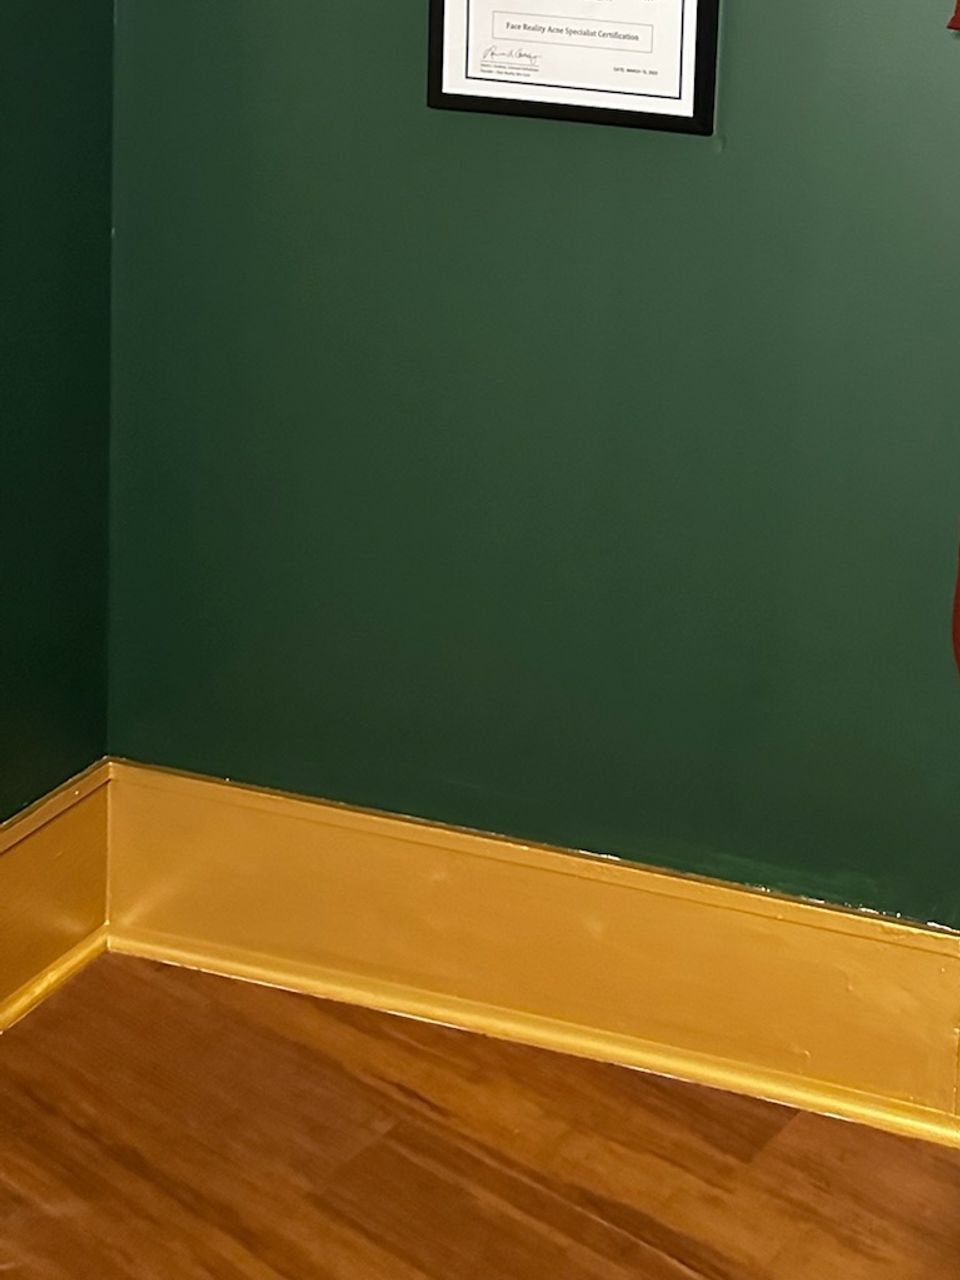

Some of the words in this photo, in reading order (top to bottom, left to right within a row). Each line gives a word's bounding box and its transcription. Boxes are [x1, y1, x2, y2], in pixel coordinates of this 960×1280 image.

[505, 21, 522, 31] Face
[522, 22, 546, 34] Reality
[547, 25, 564, 34] Acne
[564, 26, 597, 38] Specialist
[597, 29, 640, 42] Certification
